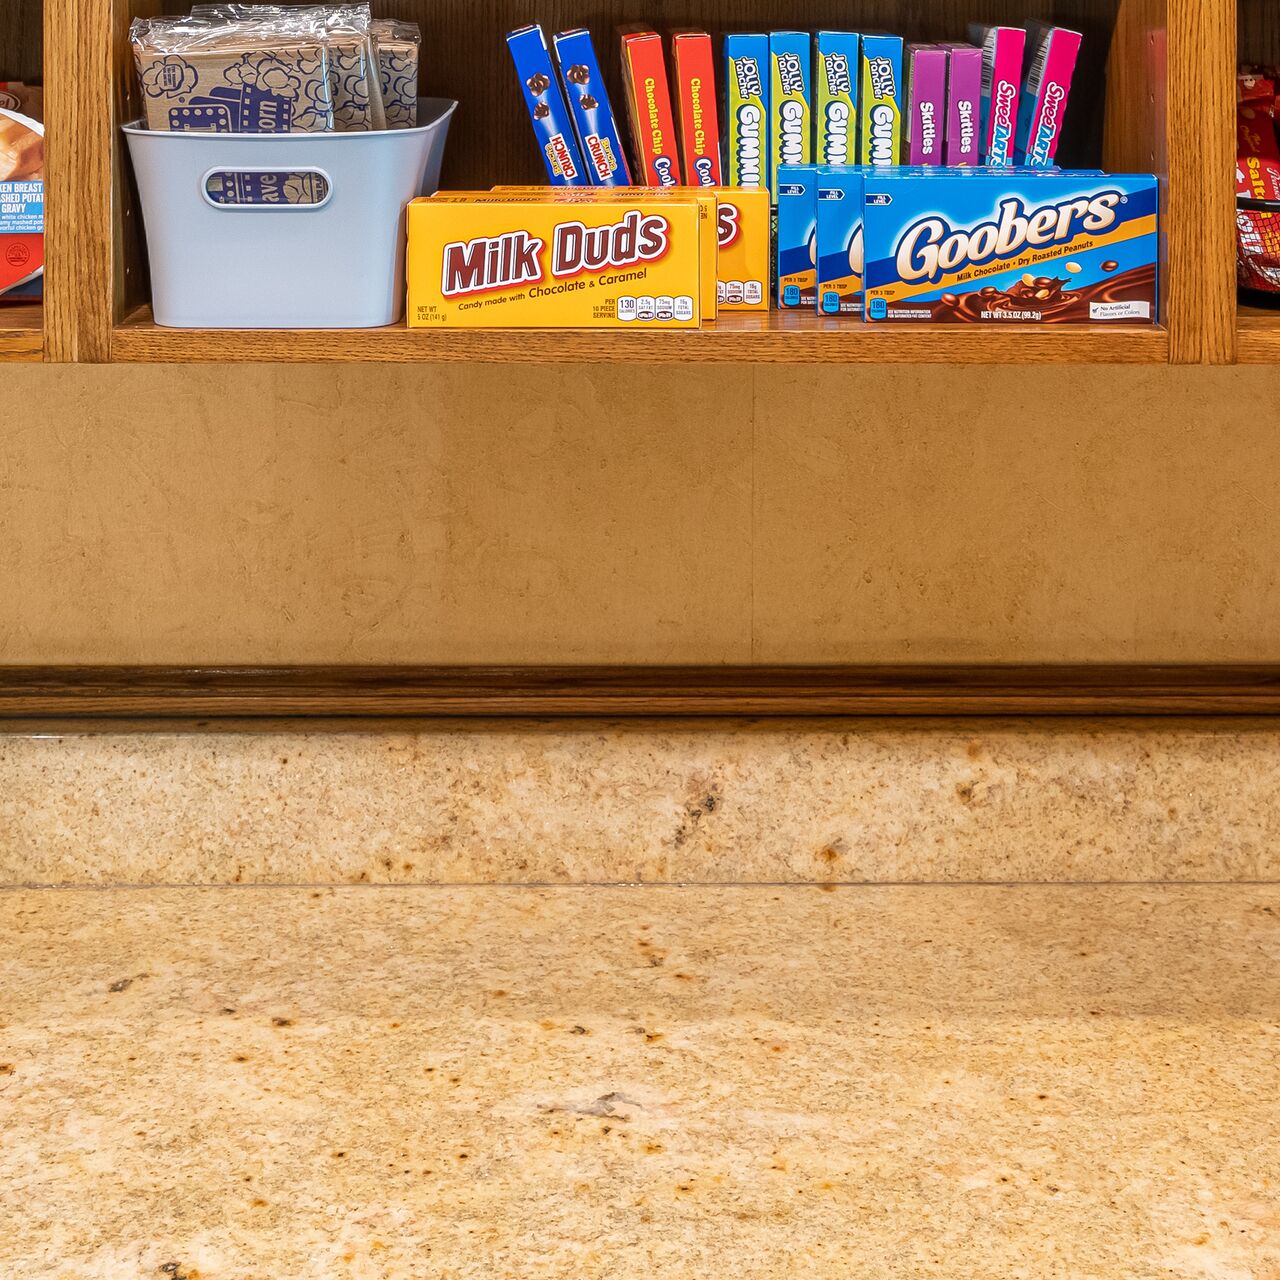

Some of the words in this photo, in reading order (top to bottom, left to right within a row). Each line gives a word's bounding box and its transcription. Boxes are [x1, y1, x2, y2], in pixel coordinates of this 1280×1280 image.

[735, 59, 749, 99] rancher
[741, 57, 761, 96] JOLLY
[645, 78, 658, 129] Chocolate
[652, 130, 662, 155] Chip
[920, 102, 934, 155] Skittles
[958, 101, 971, 153] Skittles
[551, 133, 577, 180] CRUNCH
[586, 134, 610, 180] CRUNCH
[14, 184, 43, 192] BREAST
[442, 230, 545, 296] Milk
[552, 210, 669, 279] Duds
[897, 190, 1119, 280] Goobers
[956, 272, 971, 282] Milk
[974, 262, 1010, 278] Chocolate
[1018, 257, 1030, 267] Dry
[1032, 248, 1062, 263] Roasted
[1064, 240, 1094, 256] Peanuts
[458, 301, 483, 311] Candy
[484, 297, 507, 307] made
[509, 293, 525, 302] with
[529, 280, 585, 299] Chocolate
[598, 269, 647, 286] Caramel
[620, 299, 634, 309] 130
